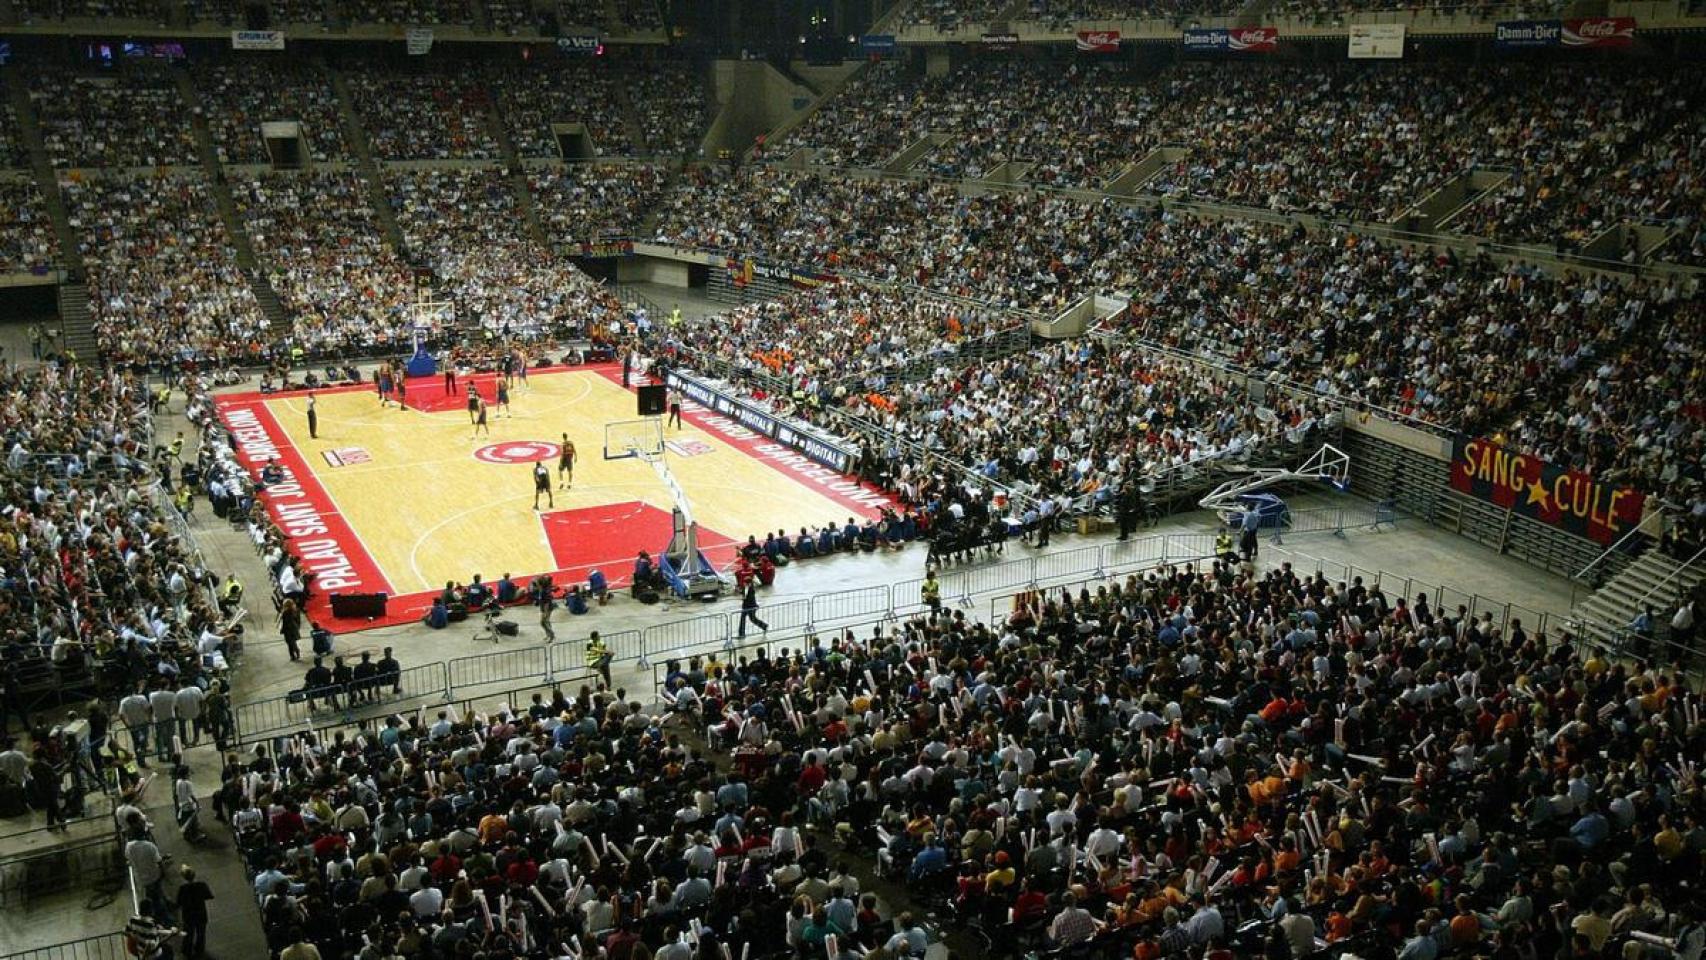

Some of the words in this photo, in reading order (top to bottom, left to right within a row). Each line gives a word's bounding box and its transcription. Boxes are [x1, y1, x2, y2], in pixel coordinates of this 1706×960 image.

[1463, 442, 1526, 492] SANG
[276, 502, 328, 536] SANT
[297, 538, 362, 590] PALAU
